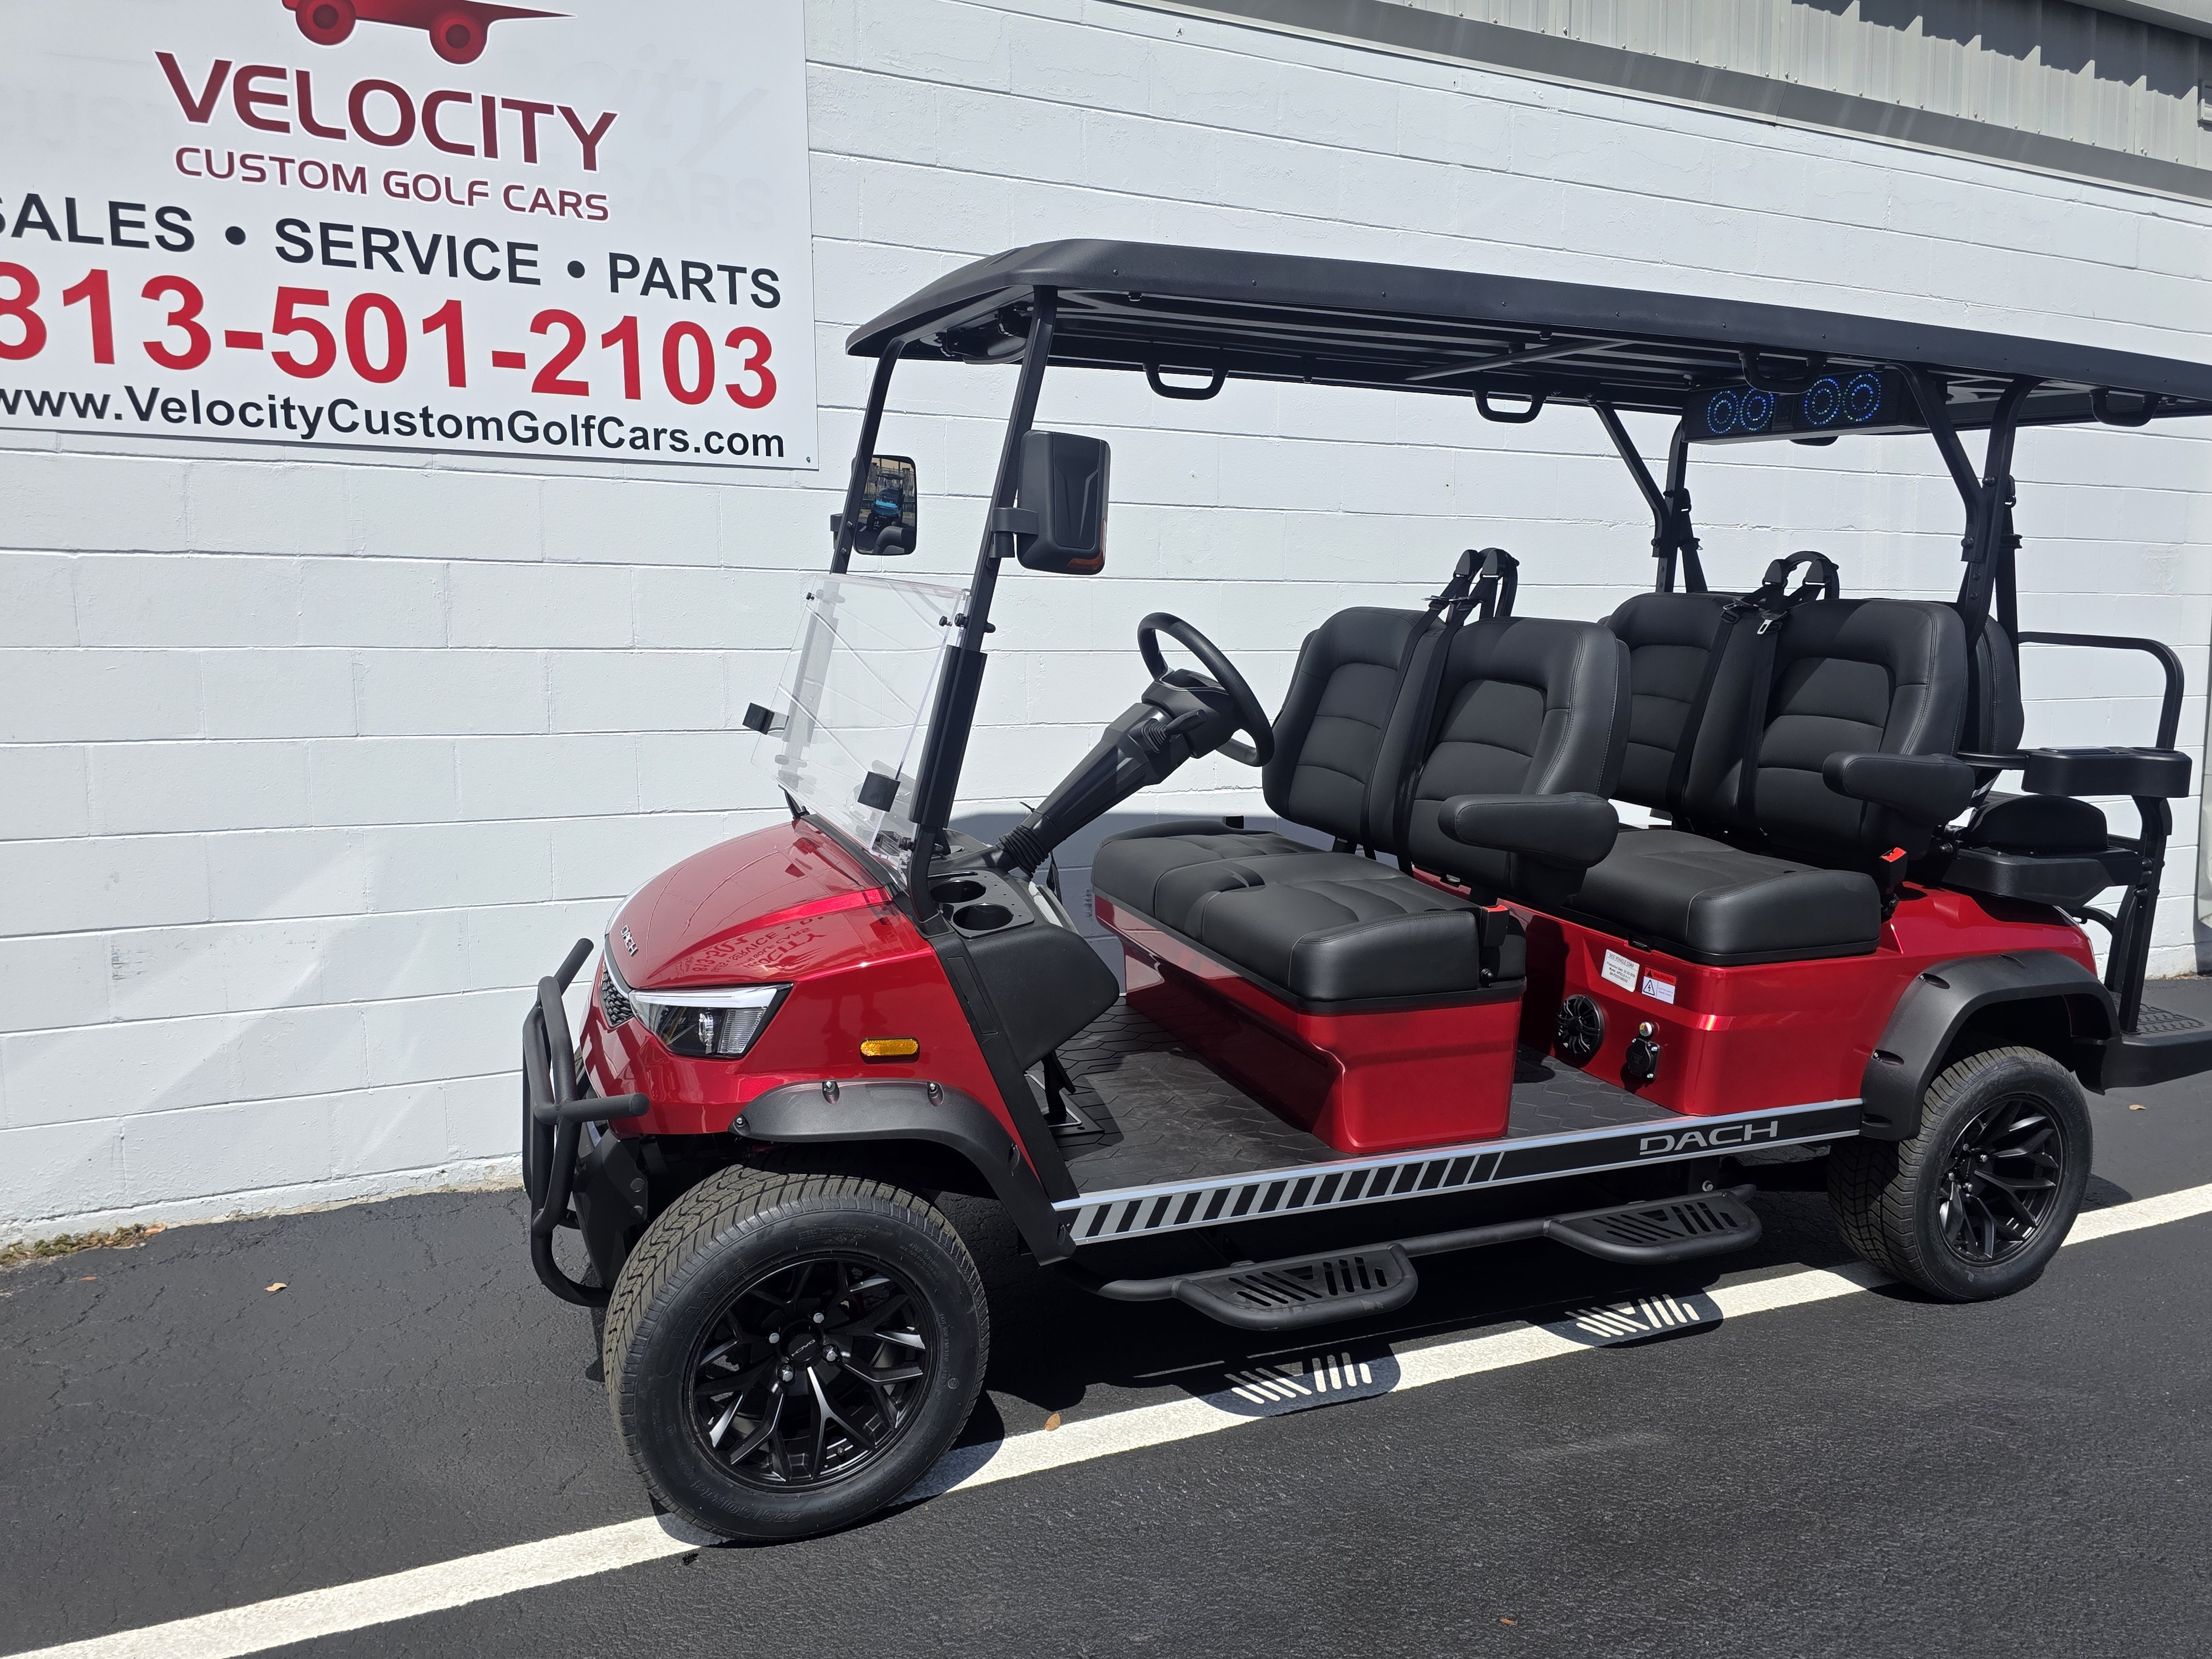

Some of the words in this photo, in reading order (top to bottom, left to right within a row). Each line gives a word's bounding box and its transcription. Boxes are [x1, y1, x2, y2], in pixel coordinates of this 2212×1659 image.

[155, 51, 618, 171] VELOCITY
[176, 147, 368, 195] CUSTOM
[383, 170, 489, 207] GOLF
[503, 185, 609, 221] CARS
[0, 192, 195, 253] ALES
[275, 218, 541, 286] SERVICE
[608, 252, 781, 309] PARTS
[0, 261, 778, 410] 813-501-2103
[0, 385, 785, 458] www.VelocityCustomGolfCars.com
[620, 924, 639, 956] DACH
[1654, 972, 1674, 983] WARNING
[1639, 1120, 1779, 1155] DACH
[791, 1339, 816, 1357] DACH
